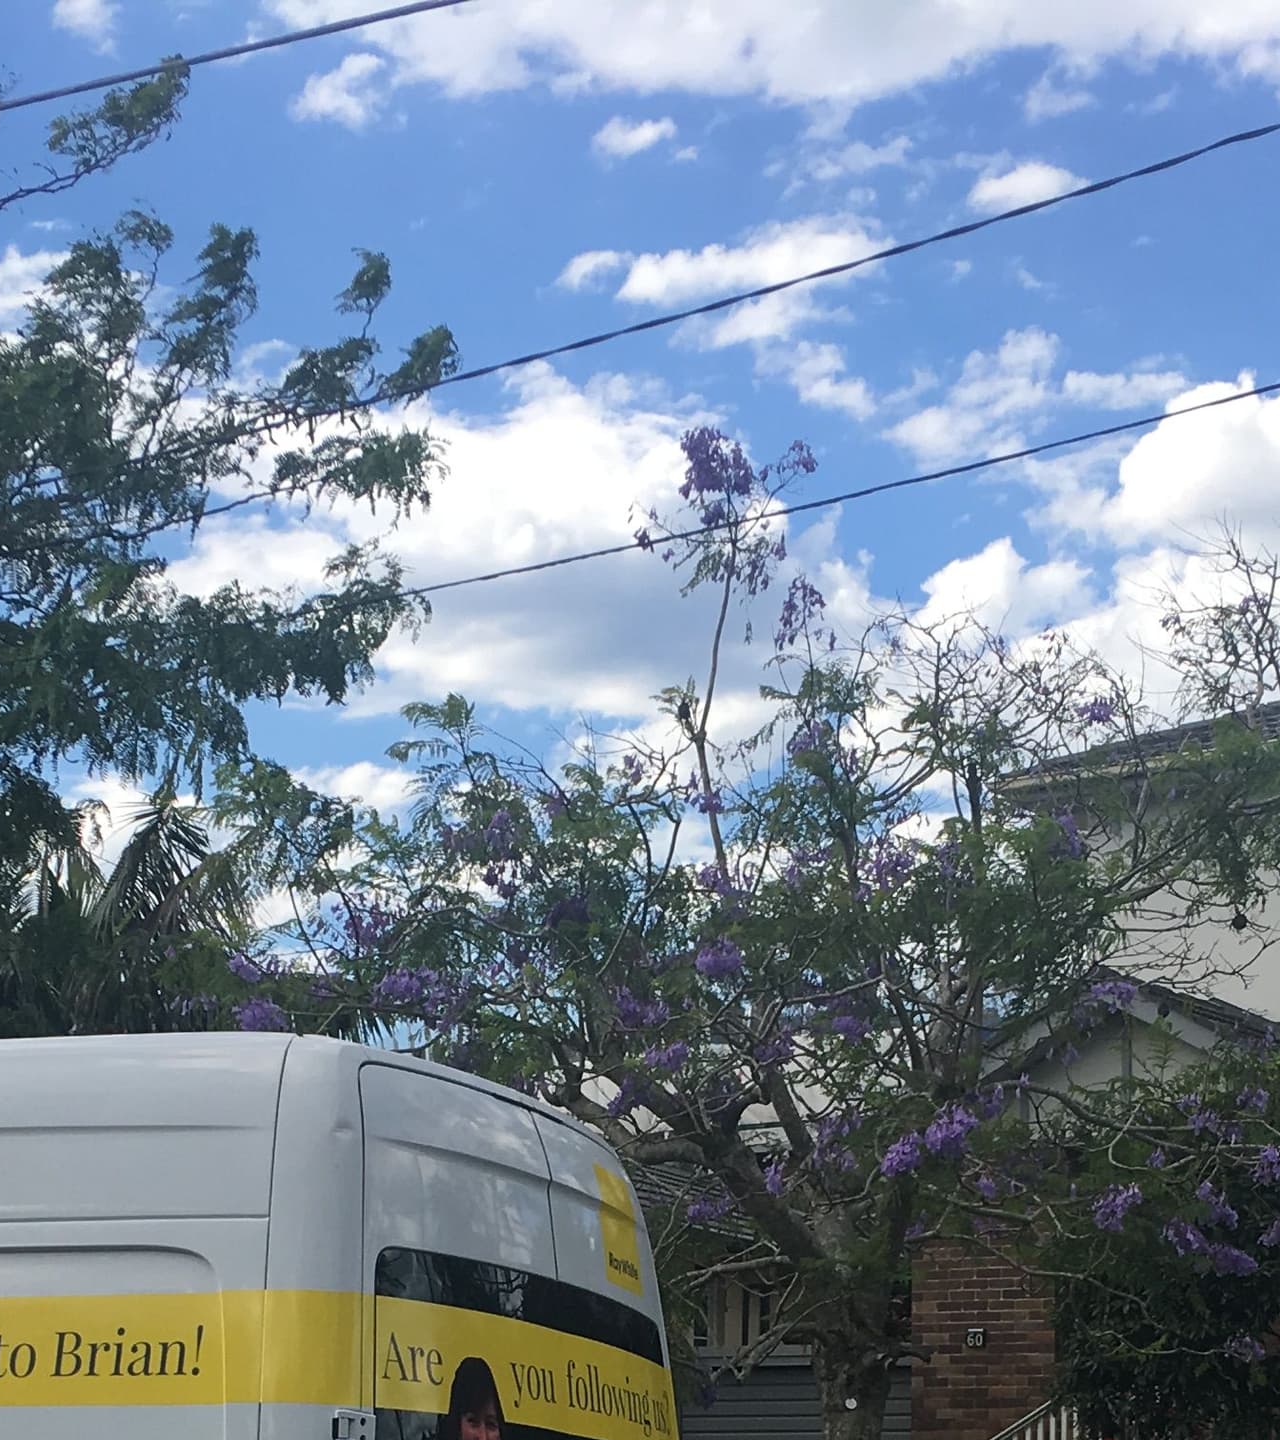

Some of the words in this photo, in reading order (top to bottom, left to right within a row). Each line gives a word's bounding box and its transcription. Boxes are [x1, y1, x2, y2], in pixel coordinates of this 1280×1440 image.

[49, 1324, 205, 1377] Brian!
[966, 1332, 984, 1347] 60
[381, 1331, 445, 1387] Are
[510, 1361, 557, 1409] you
[566, 1359, 652, 1438] following
